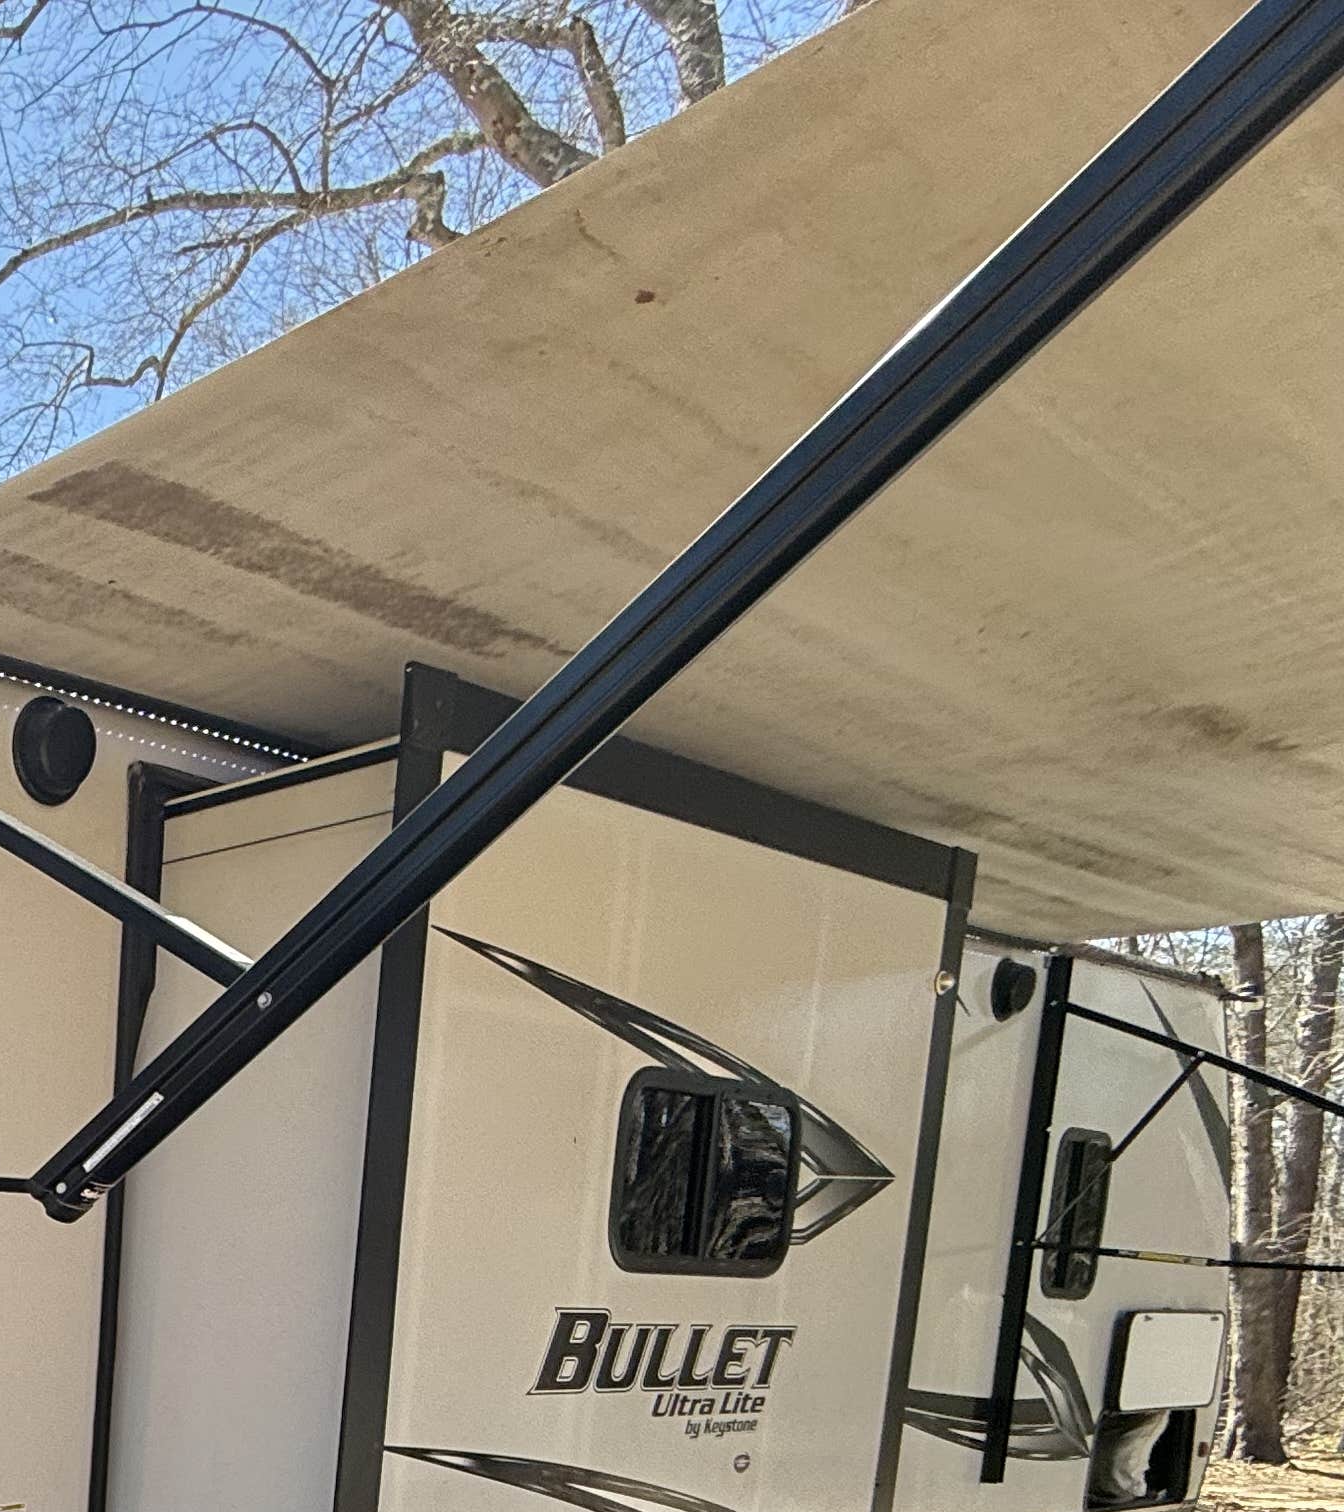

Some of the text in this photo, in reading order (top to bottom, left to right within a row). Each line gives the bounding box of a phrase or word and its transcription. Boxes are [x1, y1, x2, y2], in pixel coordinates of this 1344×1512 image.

[526, 1306, 798, 1395] BULLET
[652, 1392, 766, 1417] Ultra Lite
[684, 1418, 758, 1439] by Keystone
